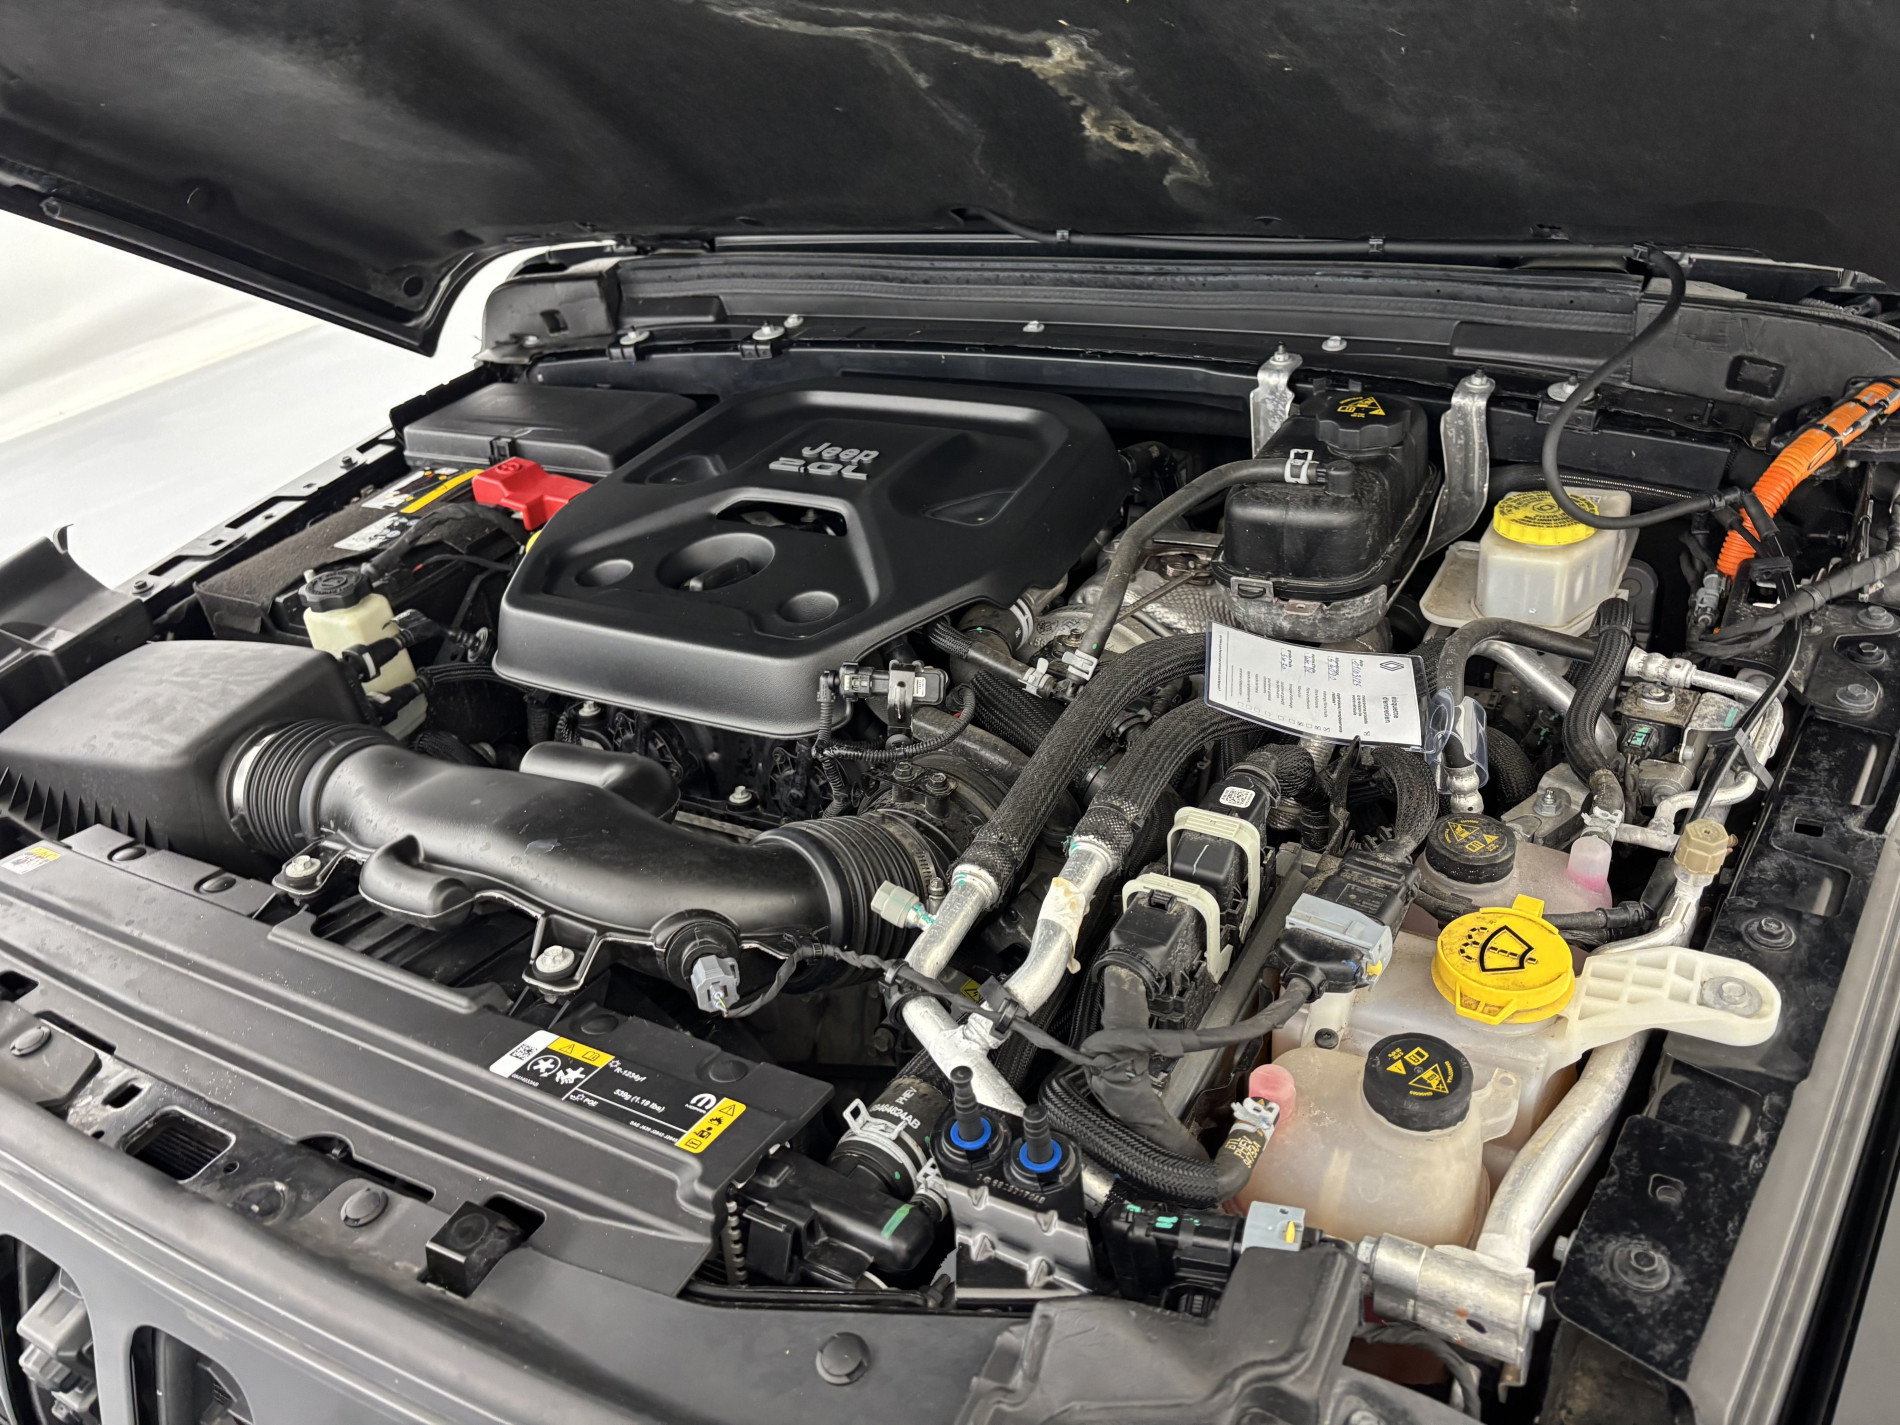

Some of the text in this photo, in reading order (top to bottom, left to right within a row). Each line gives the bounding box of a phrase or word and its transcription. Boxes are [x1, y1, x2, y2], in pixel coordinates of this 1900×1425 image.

[802, 442, 879, 465] Jeep
[769, 457, 867, 480] 2.0L
[613, 1066, 647, 1082] R-1234yf
[583, 1097, 599, 1107] POE
[613, 1088, 632, 1101] 539g
[895, 1086, 917, 1105] PHEV
[1233, 1135, 1254, 1160] PHEV
